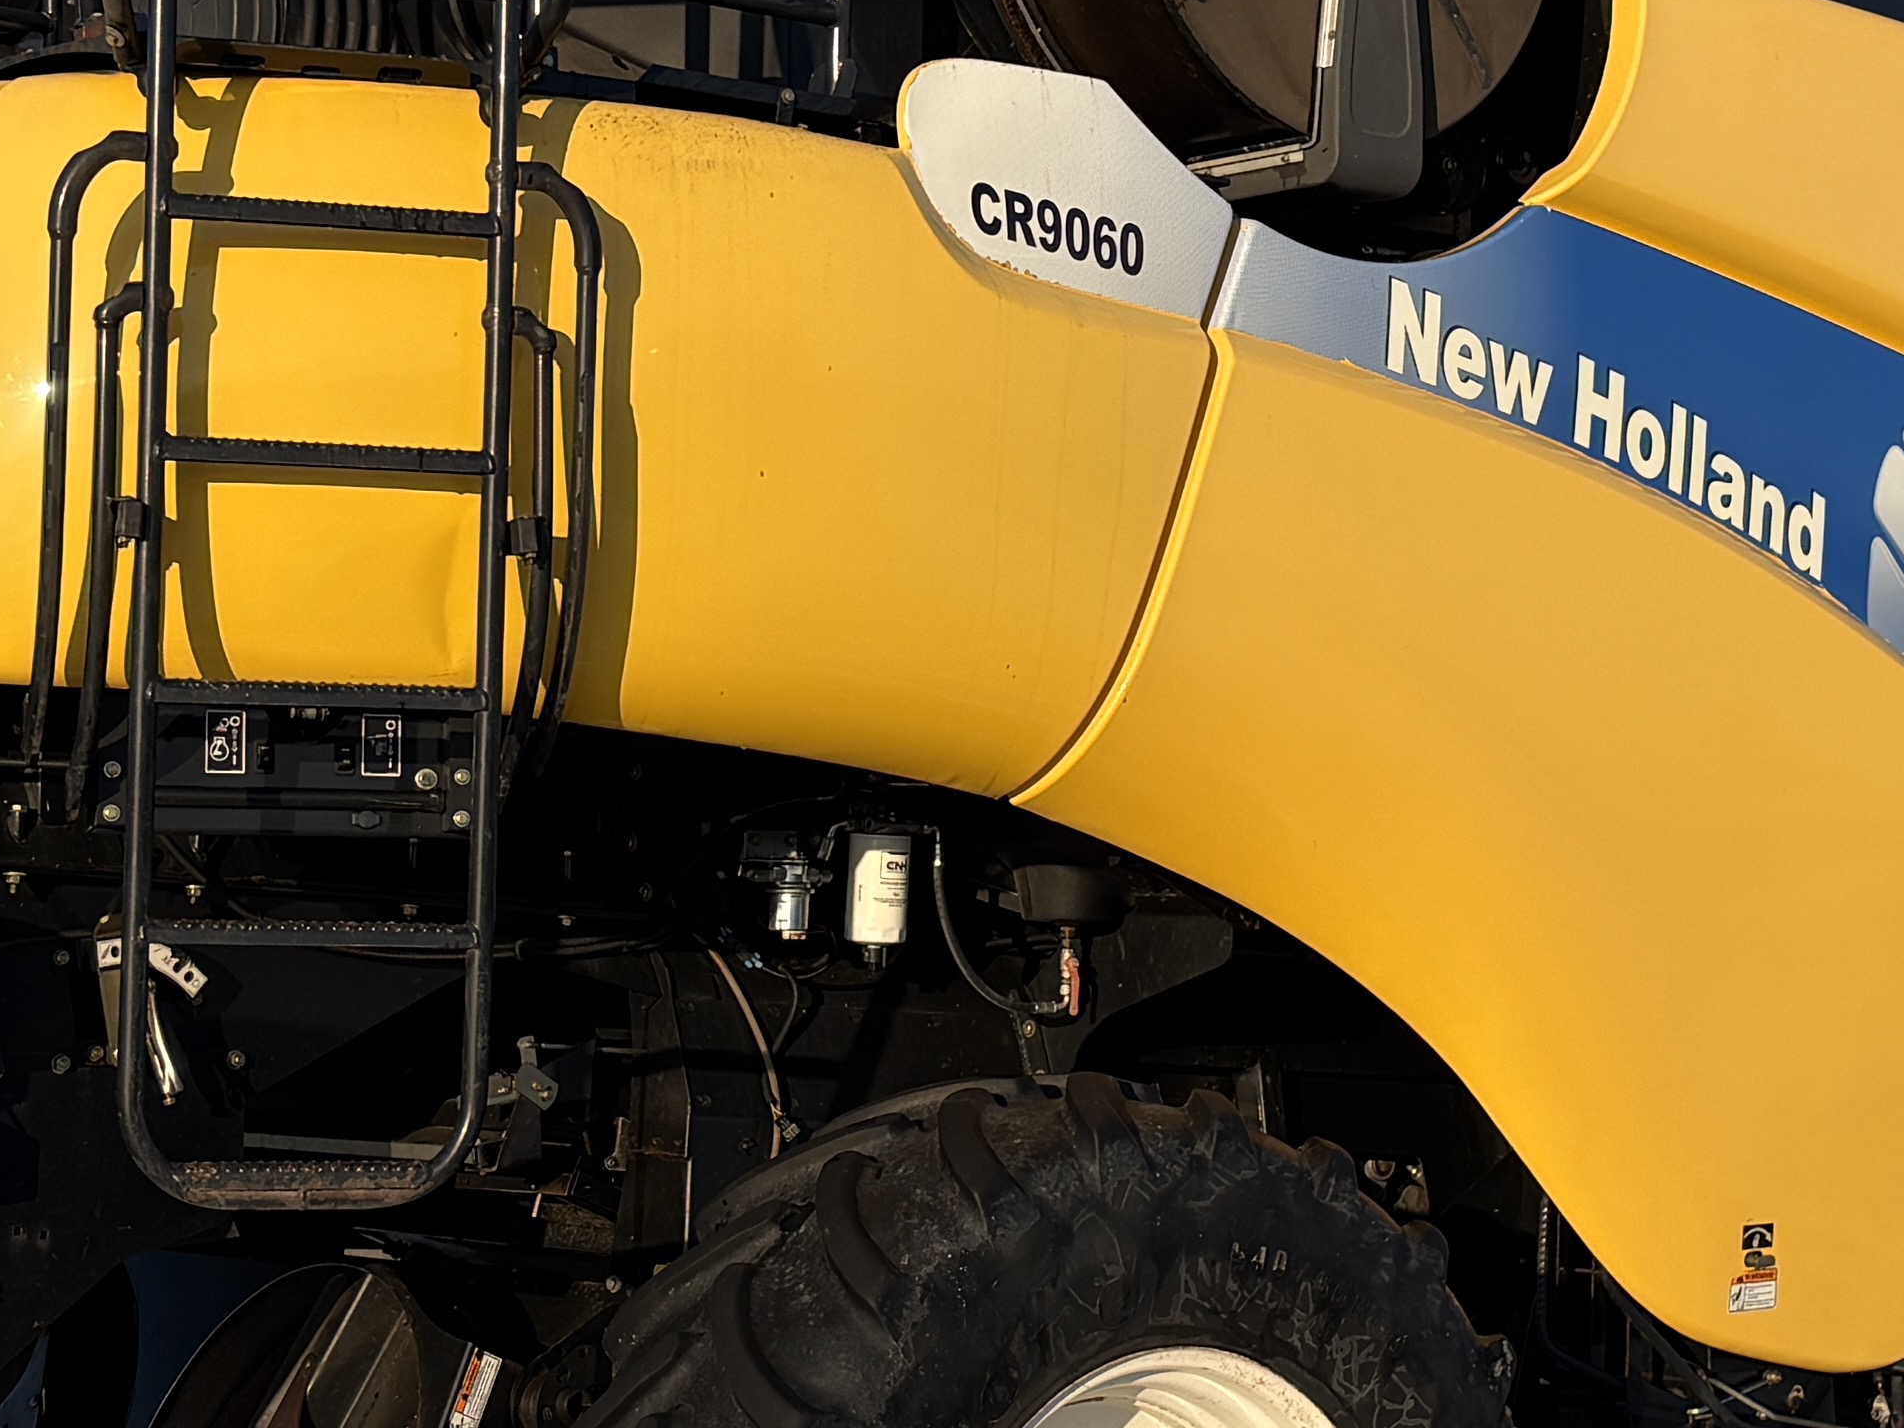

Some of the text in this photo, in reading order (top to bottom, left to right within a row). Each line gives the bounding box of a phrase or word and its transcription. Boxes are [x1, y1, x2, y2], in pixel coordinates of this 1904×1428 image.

[971, 181, 1144, 277] CR9060
[1386, 276, 1826, 582] New Holland
